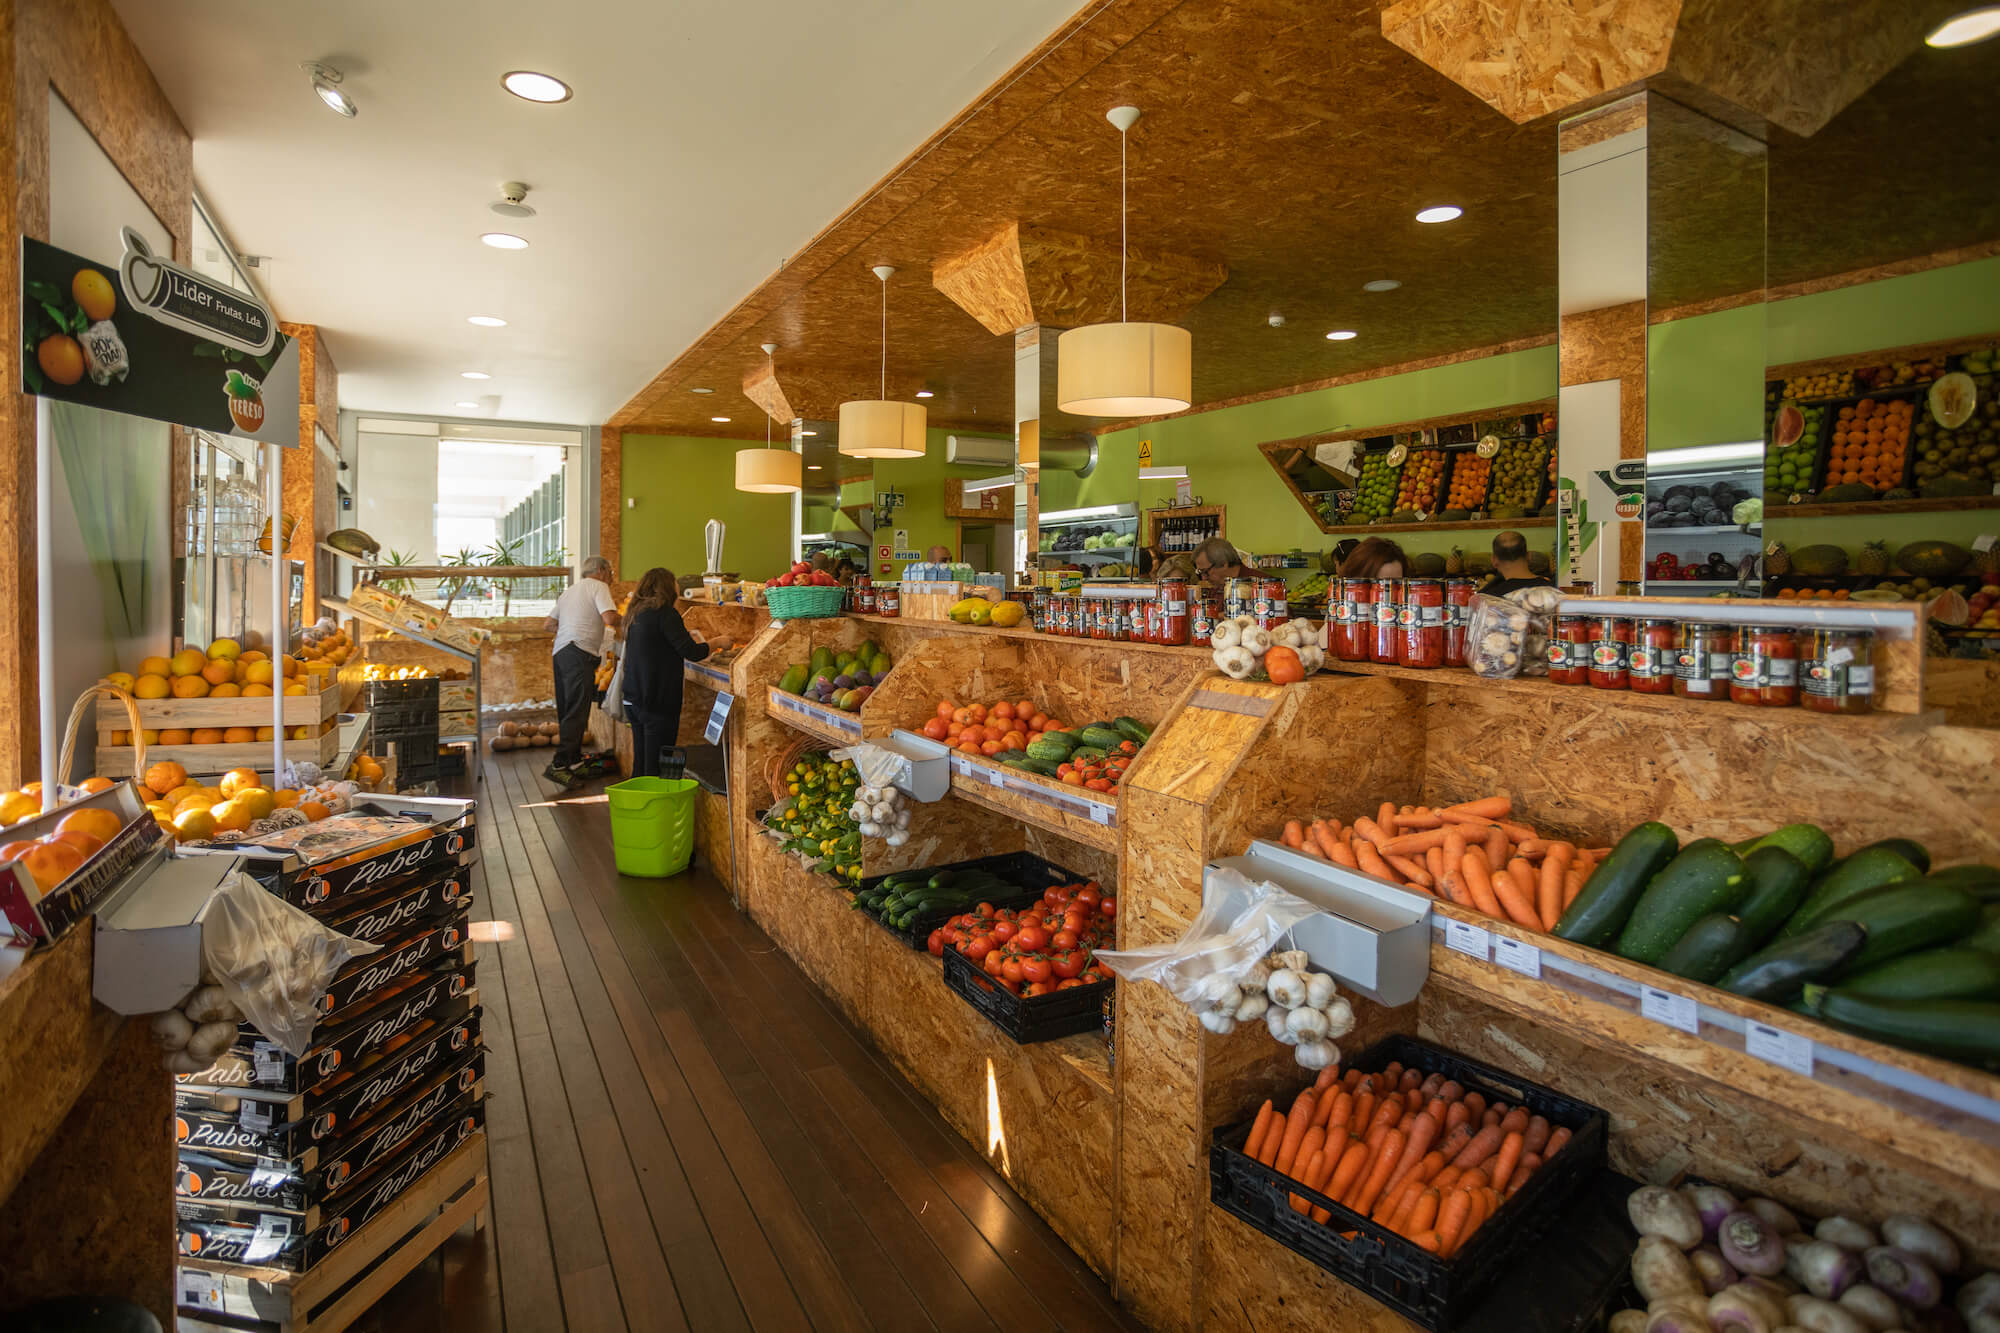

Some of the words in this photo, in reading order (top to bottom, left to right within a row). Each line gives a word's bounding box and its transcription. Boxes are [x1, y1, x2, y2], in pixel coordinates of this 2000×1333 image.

[174, 276, 213, 308] Líder
[232, 399, 263, 420] TERESO
[344, 839, 434, 894] Pabel
[351, 889, 432, 940] Pabel
[346, 937, 432, 1004] Pabel
[353, 987, 438, 1059] Pabel
[189, 1063, 258, 1084] Pabe
[348, 1041, 439, 1120] Pabel
[361, 1083, 447, 1167] Pabel
[361, 1133, 446, 1222] Pabel
